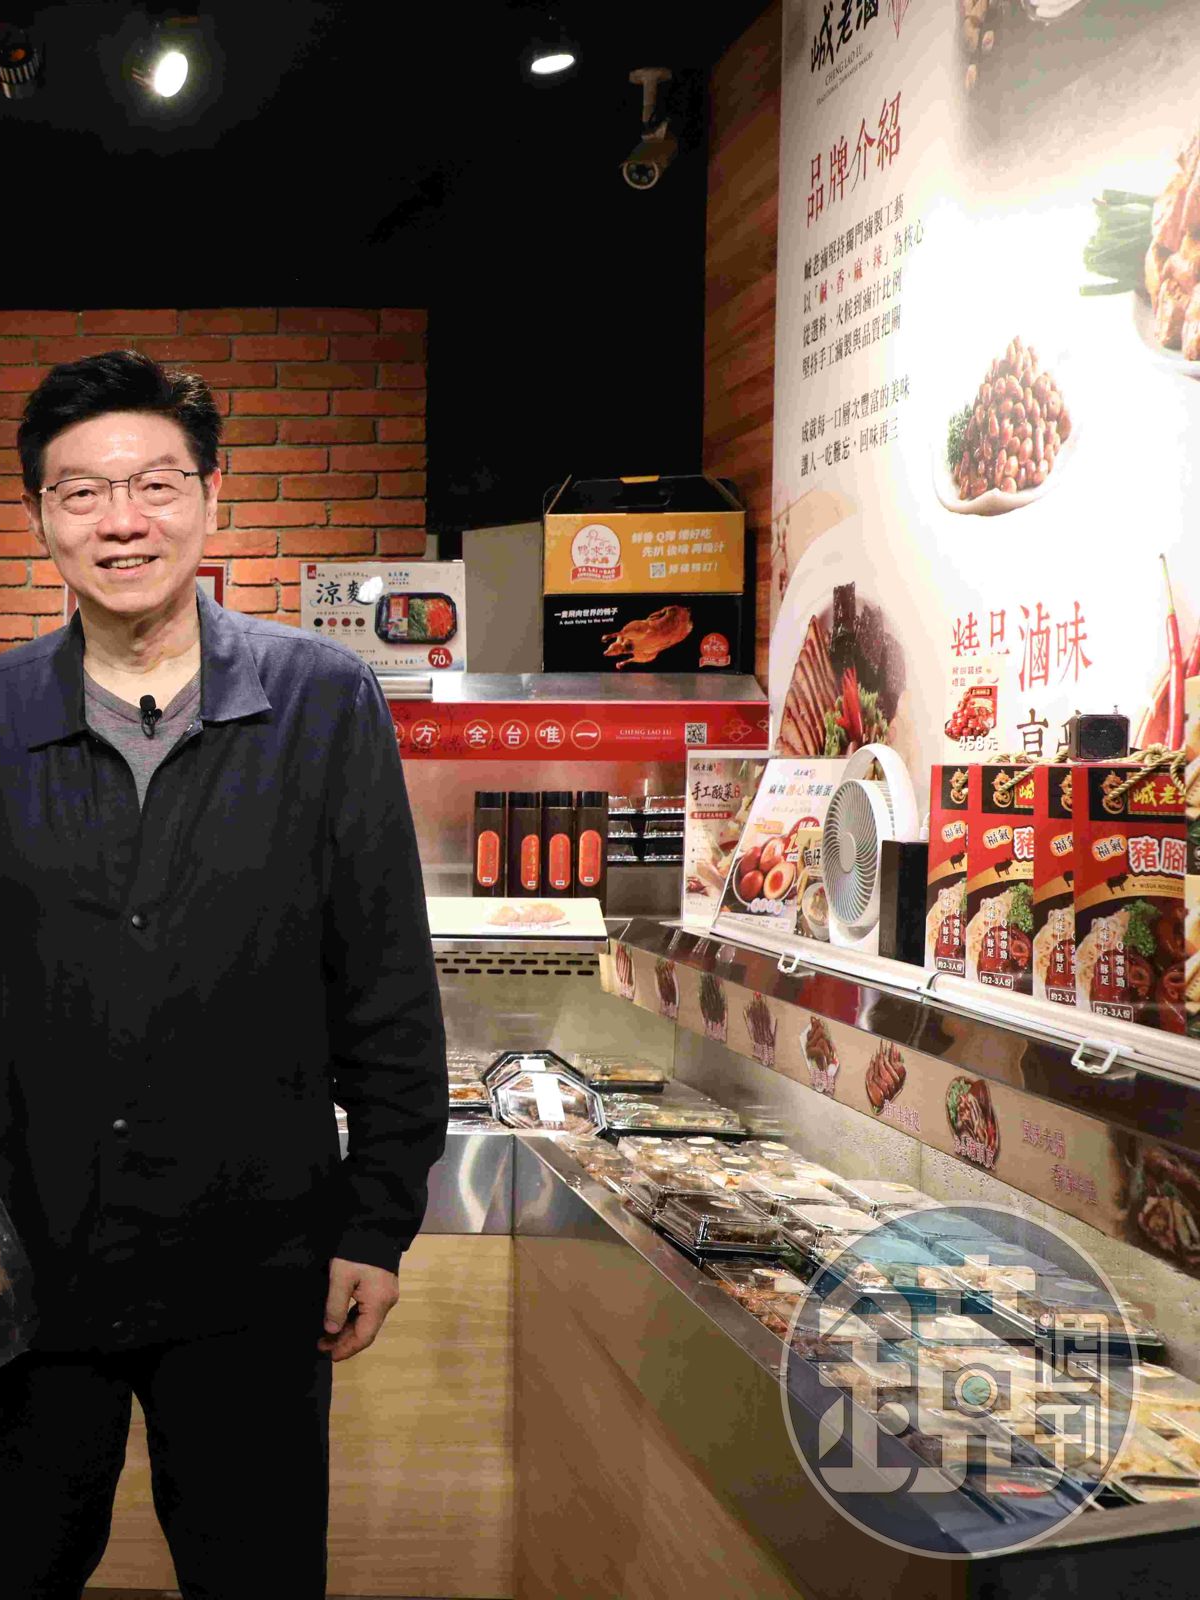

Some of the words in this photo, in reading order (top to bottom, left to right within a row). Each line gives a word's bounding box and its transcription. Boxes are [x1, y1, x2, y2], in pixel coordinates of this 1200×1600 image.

[806, 91, 901, 229] 品牌介紹
[467, 725, 598, 745] 全台唯一
[1096, 837, 1125, 859] 福氣
[1095, 1004, 1132, 1020] 約2-3人份
